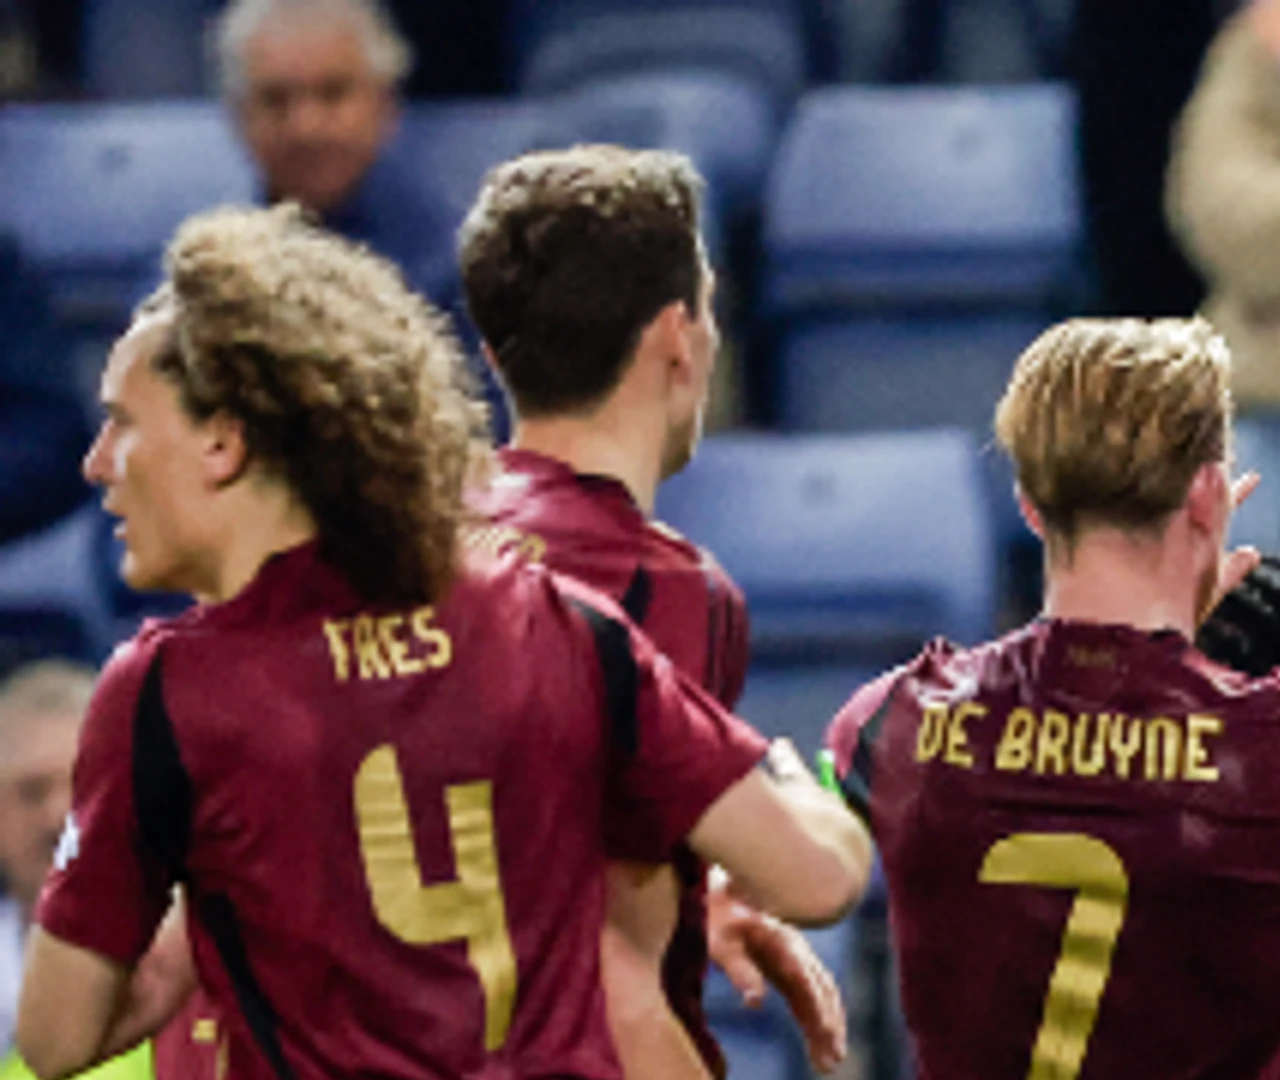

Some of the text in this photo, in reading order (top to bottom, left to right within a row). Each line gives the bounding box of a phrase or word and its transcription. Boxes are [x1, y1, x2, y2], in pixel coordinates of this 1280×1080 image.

[915, 703, 1222, 782] DE BRUYNE
[353, 744, 517, 1052] 4
